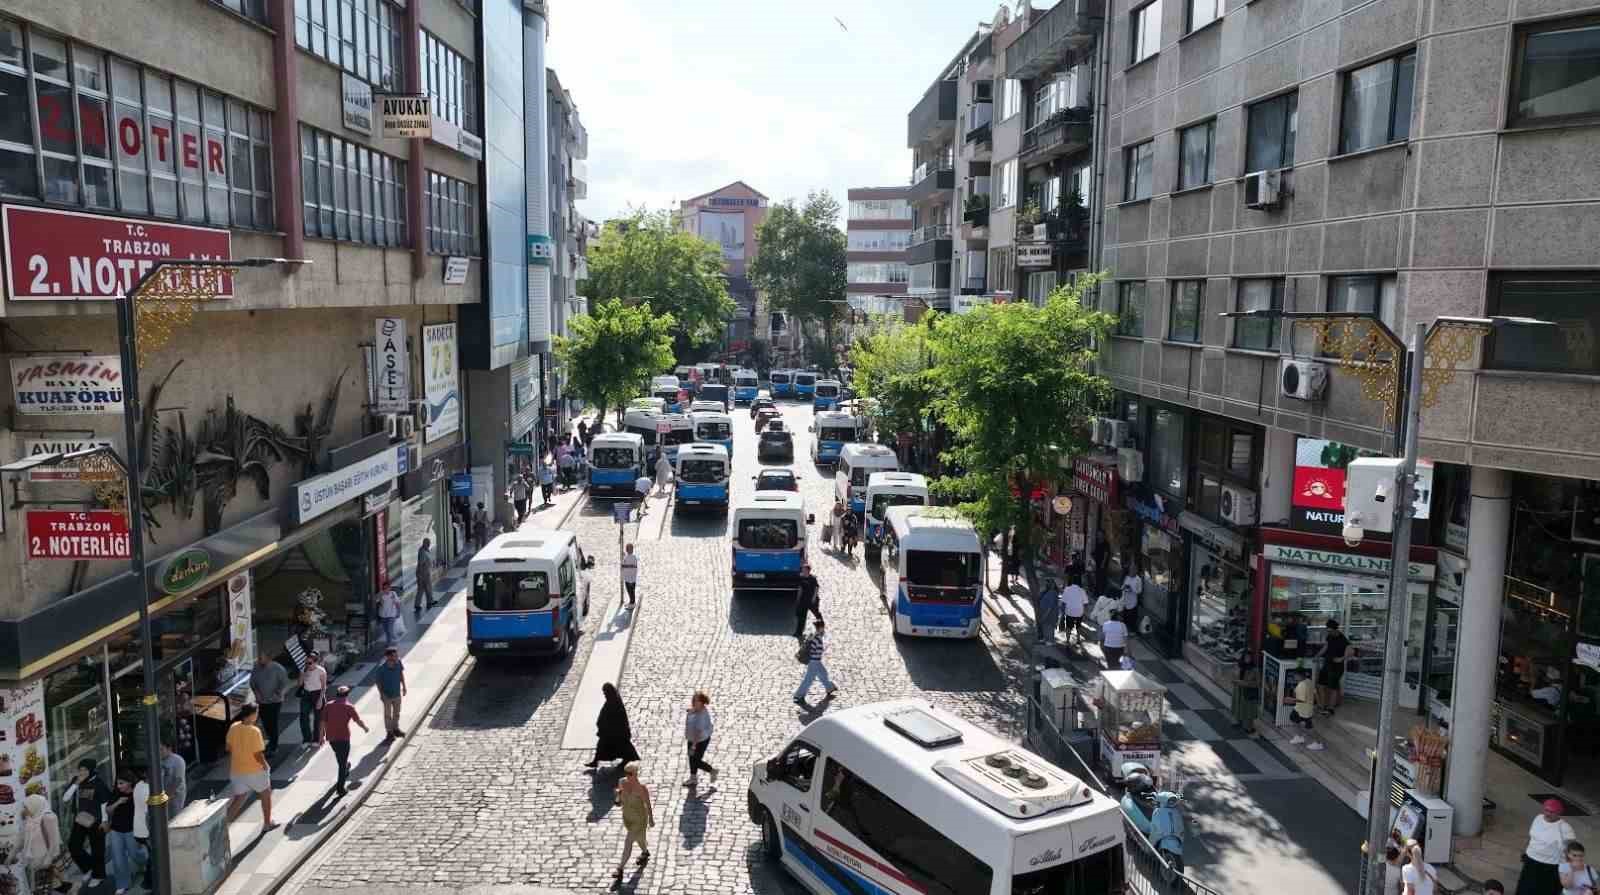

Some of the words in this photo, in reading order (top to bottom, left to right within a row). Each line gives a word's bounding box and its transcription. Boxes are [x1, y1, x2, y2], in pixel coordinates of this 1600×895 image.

[384, 99, 428, 115] AVUKAT
[79, 97, 225, 174] NOTER
[126, 224, 148, 237] T.C.
[103, 239, 171, 256] TRABZON
[28, 254, 61, 294] 2.
[17, 361, 120, 387] YASMİN
[18, 387, 122, 404] KUAFÖRÜ
[32, 442, 110, 456] AVUK
[50, 522, 111, 532] TRABZON
[32, 536, 46, 556] 2.
[49, 532, 131, 557] NOTERLİĞİ
[1278, 547, 1422, 576] NATURALNES
